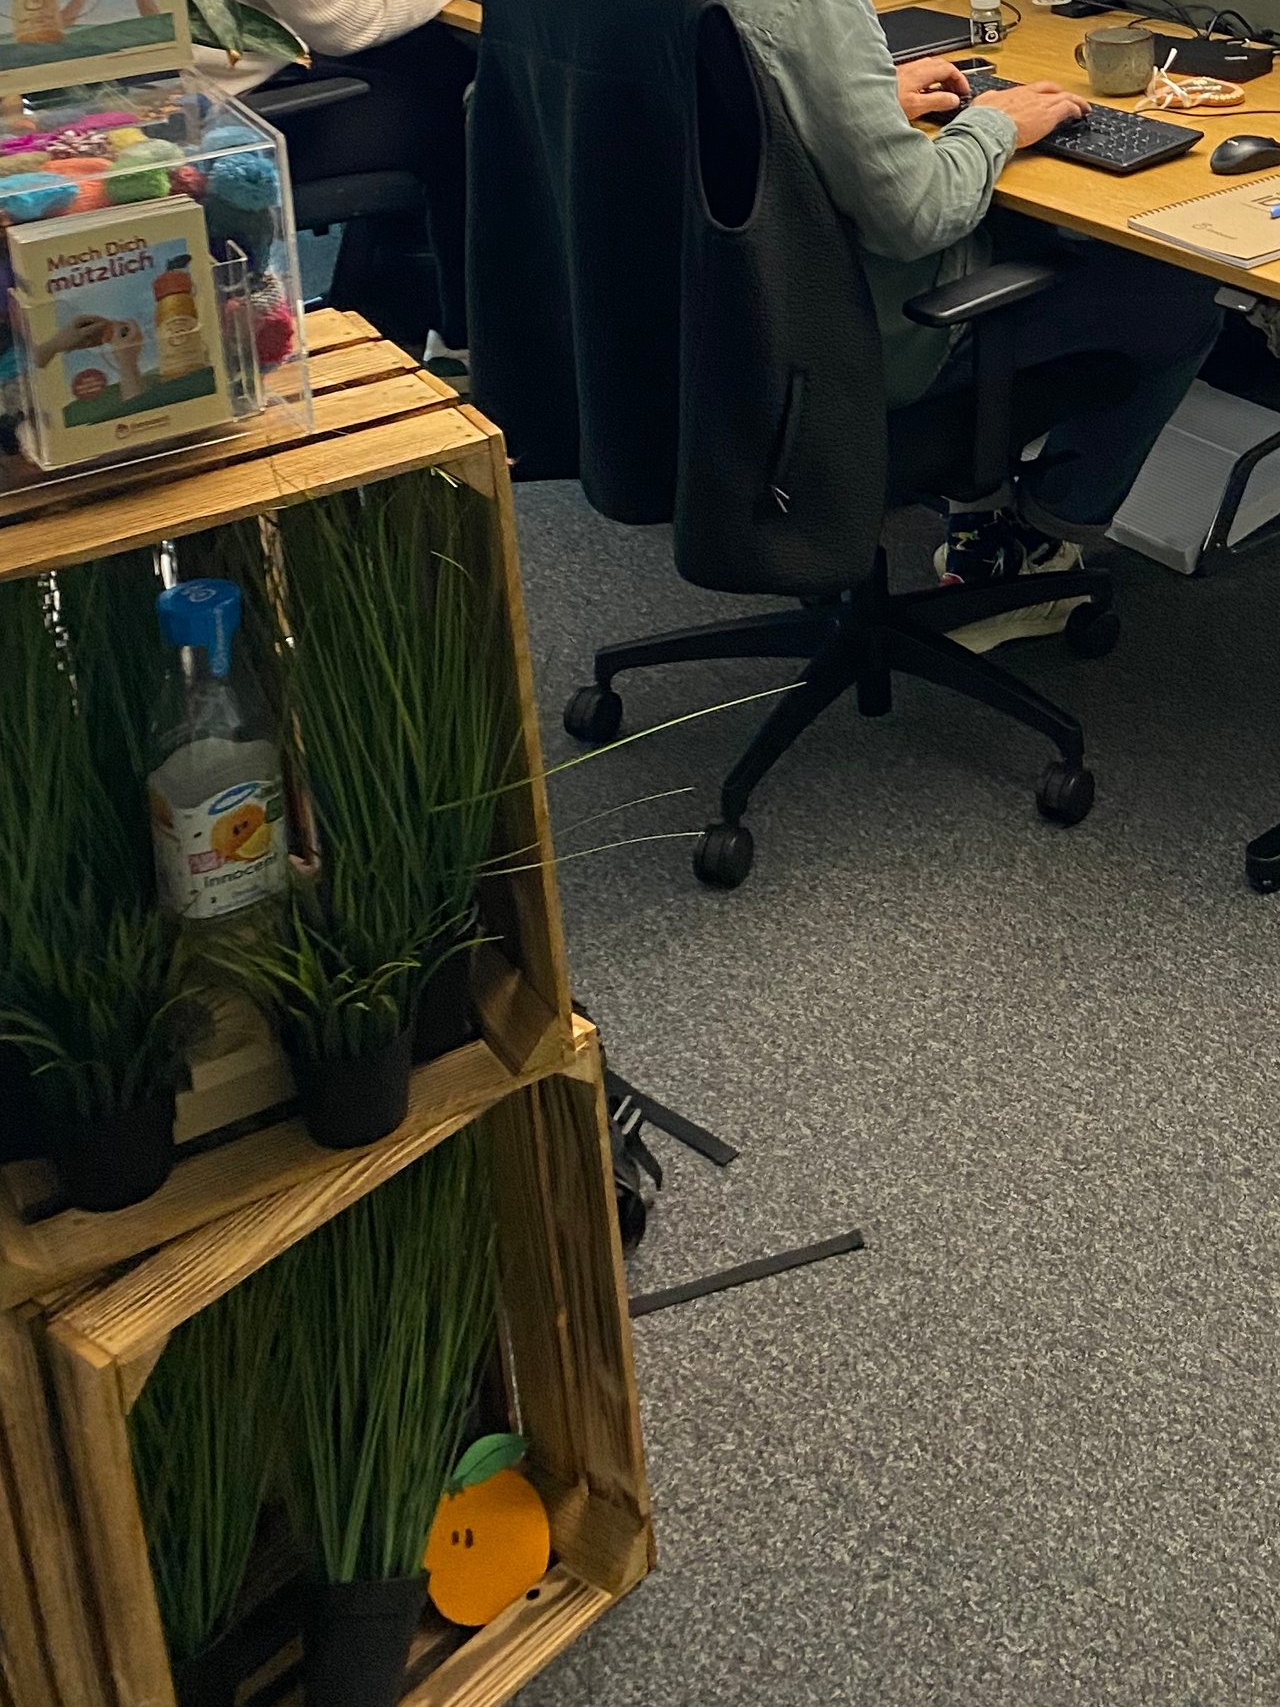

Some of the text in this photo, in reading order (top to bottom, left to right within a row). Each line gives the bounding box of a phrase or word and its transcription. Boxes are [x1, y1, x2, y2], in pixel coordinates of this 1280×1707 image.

[46, 236, 147, 272] Mach Dich
[47, 251, 154, 294] mützlich
